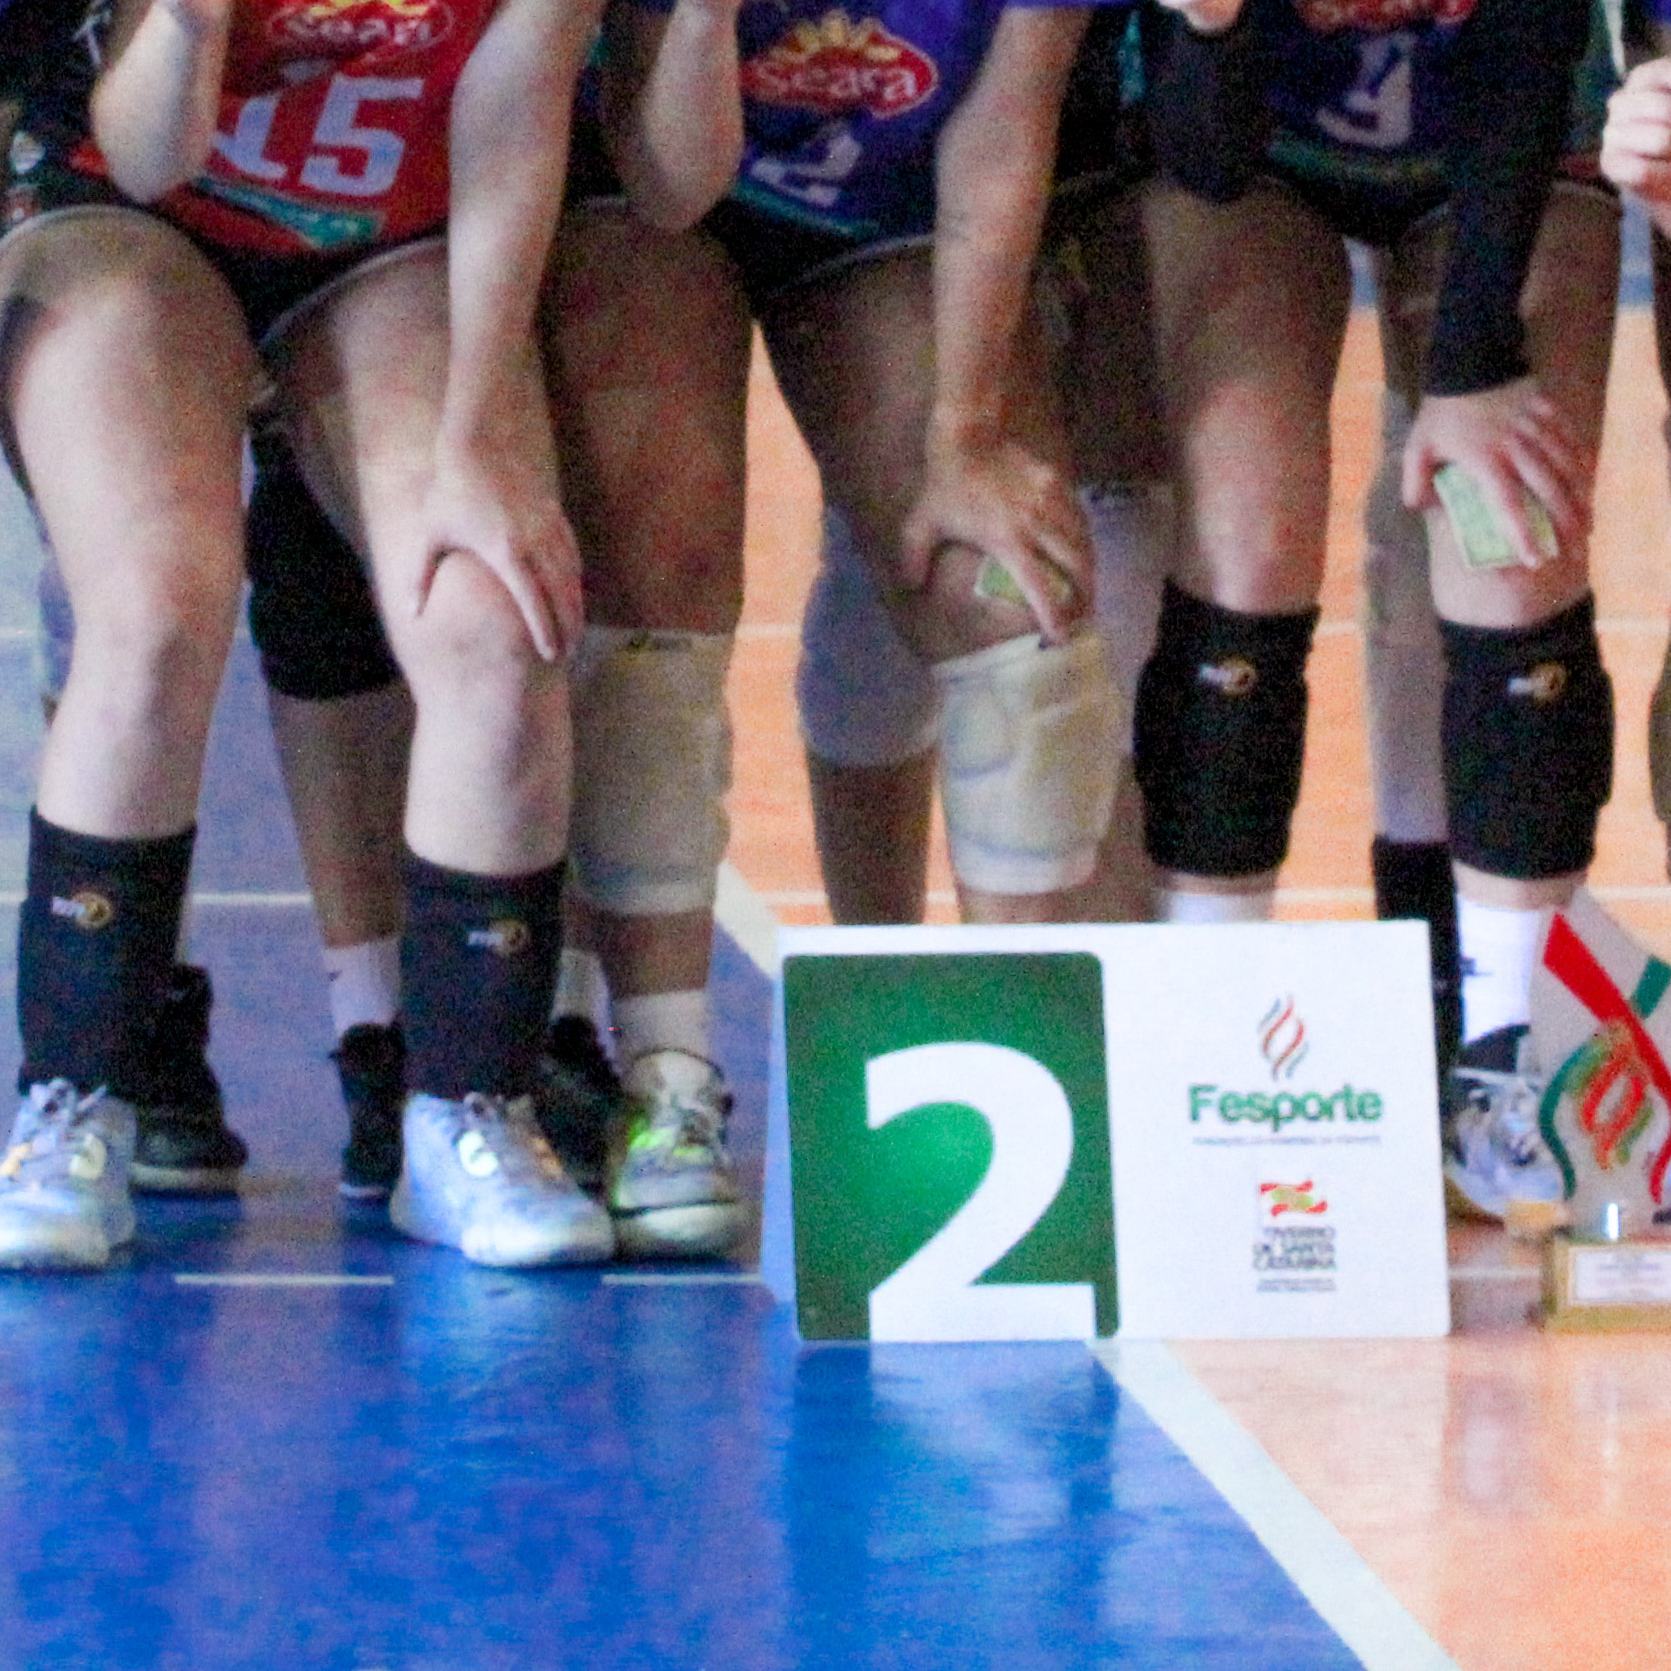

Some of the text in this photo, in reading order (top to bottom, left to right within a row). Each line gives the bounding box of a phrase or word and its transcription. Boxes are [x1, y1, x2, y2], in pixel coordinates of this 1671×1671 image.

[211, 62, 425, 197] 15
[1188, 1081, 1383, 1133] Fesporte
[865, 1041, 1096, 1342] 2
